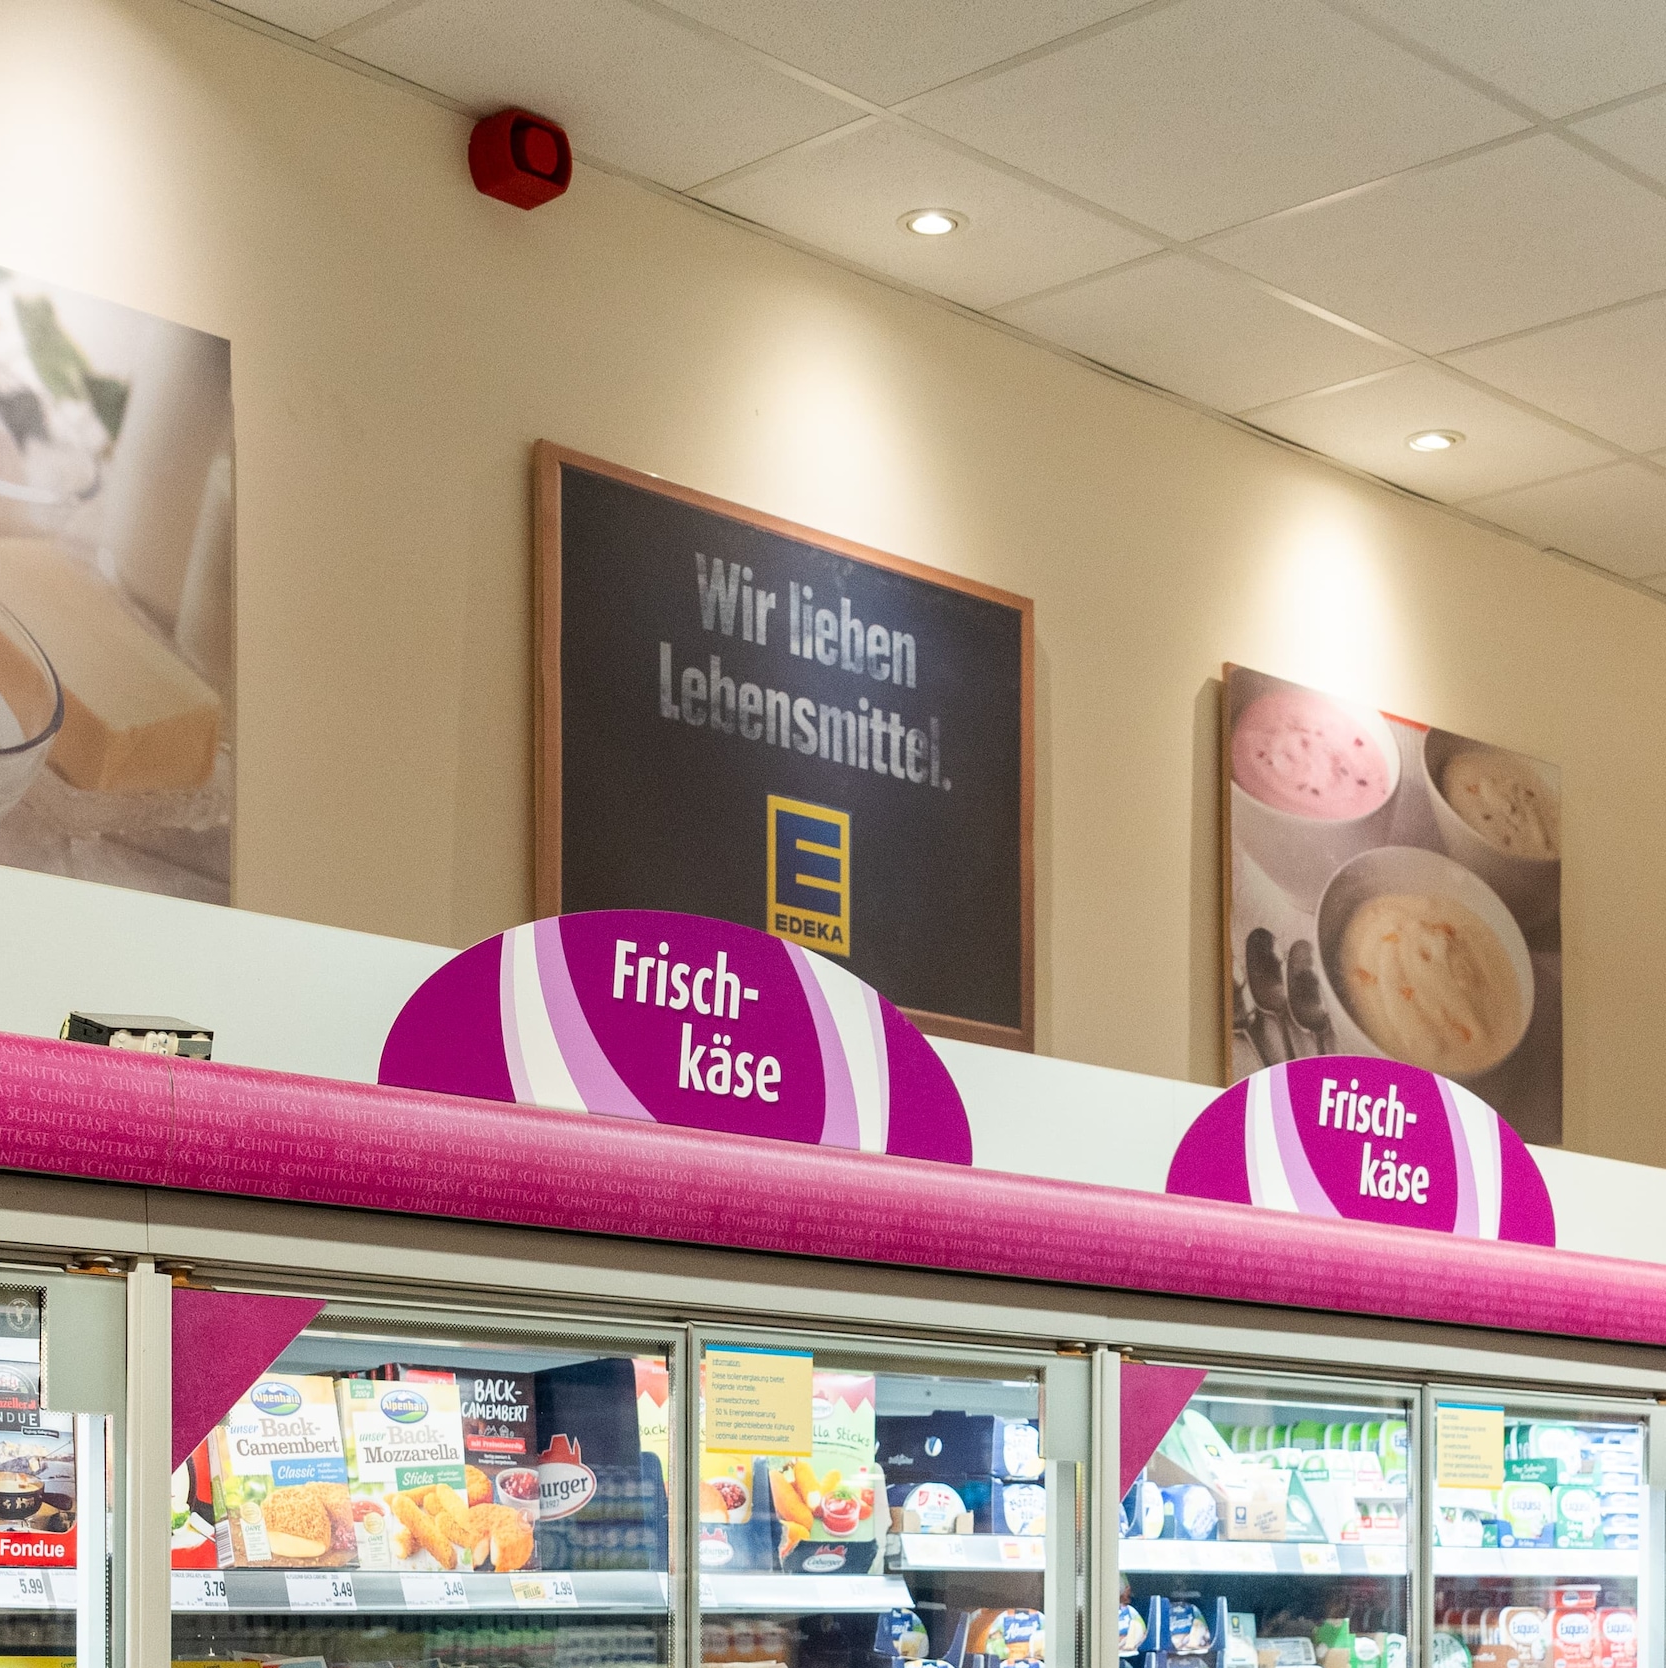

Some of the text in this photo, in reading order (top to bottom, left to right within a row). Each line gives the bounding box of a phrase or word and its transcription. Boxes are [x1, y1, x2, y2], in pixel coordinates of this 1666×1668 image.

[695, 552, 916, 688] Wir lieben
[659, 641, 951, 790] Lebensmittel.
[775, 913, 844, 944] EDEKA
[613, 939, 759, 1019] Frisch-
[679, 1022, 781, 1102] käse
[1318, 1079, 1417, 1140] Frisch-
[1359, 1143, 1429, 1205] käse
[474, 1378, 522, 1402] BACK-
[461, 1401, 529, 1422] CAMEMBERT
[260, 1417, 321, 1437] Back-
[388, 1425, 445, 1445] Back-
[236, 1436, 340, 1456] Camembert
[365, 1443, 459, 1463] Mozzarella
[0, 1539, 65, 1558] Fondue
[20, 1578, 43, 1594] 5.99
[332, 1579, 353, 1597] 3.49
